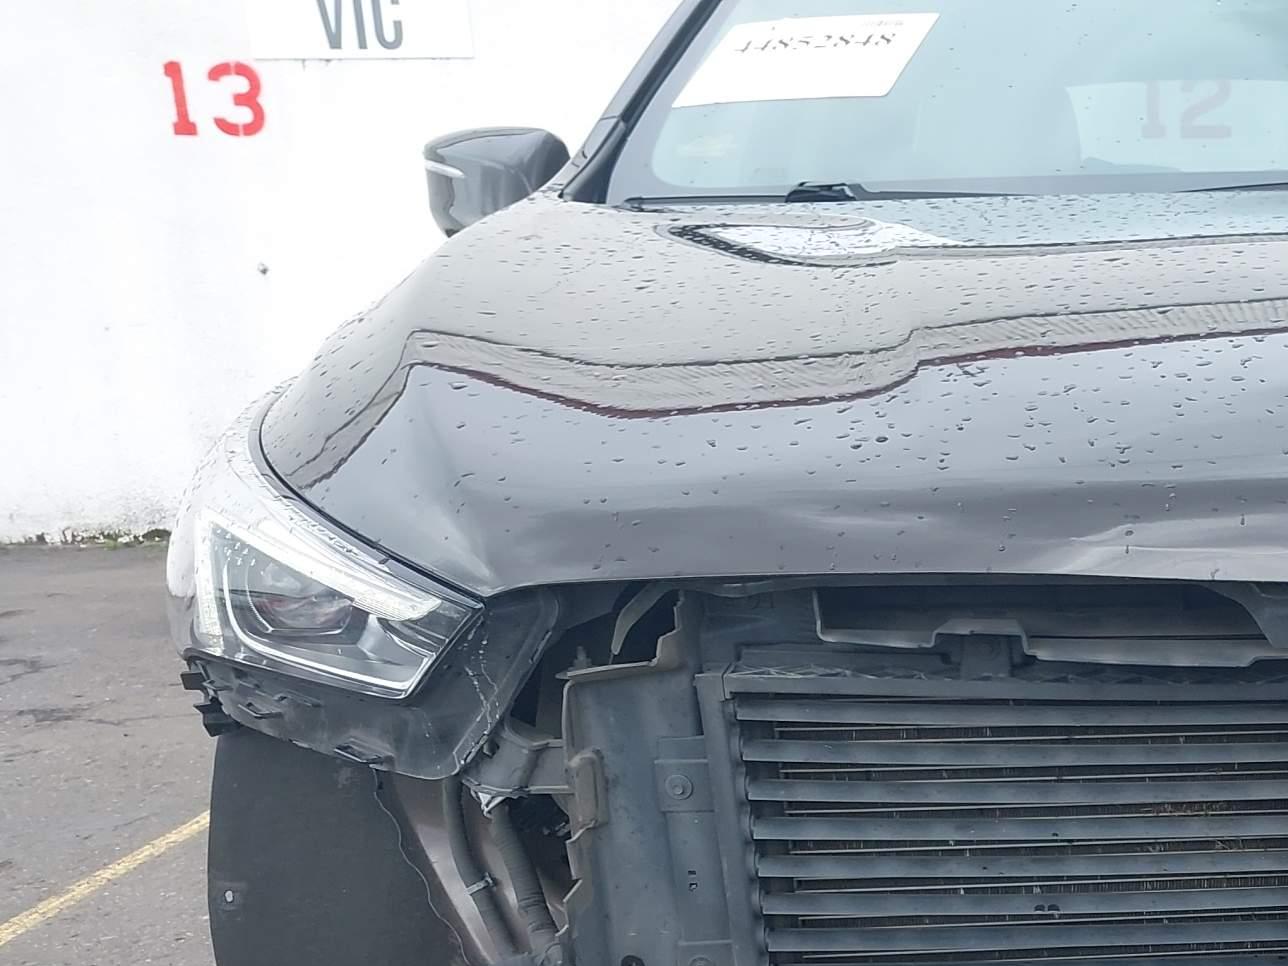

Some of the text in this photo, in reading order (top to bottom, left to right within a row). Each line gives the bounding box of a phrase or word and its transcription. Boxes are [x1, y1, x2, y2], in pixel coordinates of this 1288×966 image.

[316, 0, 404, 50] VIC
[163, 60, 265, 137] 13
[1140, 79, 1232, 139] 12
